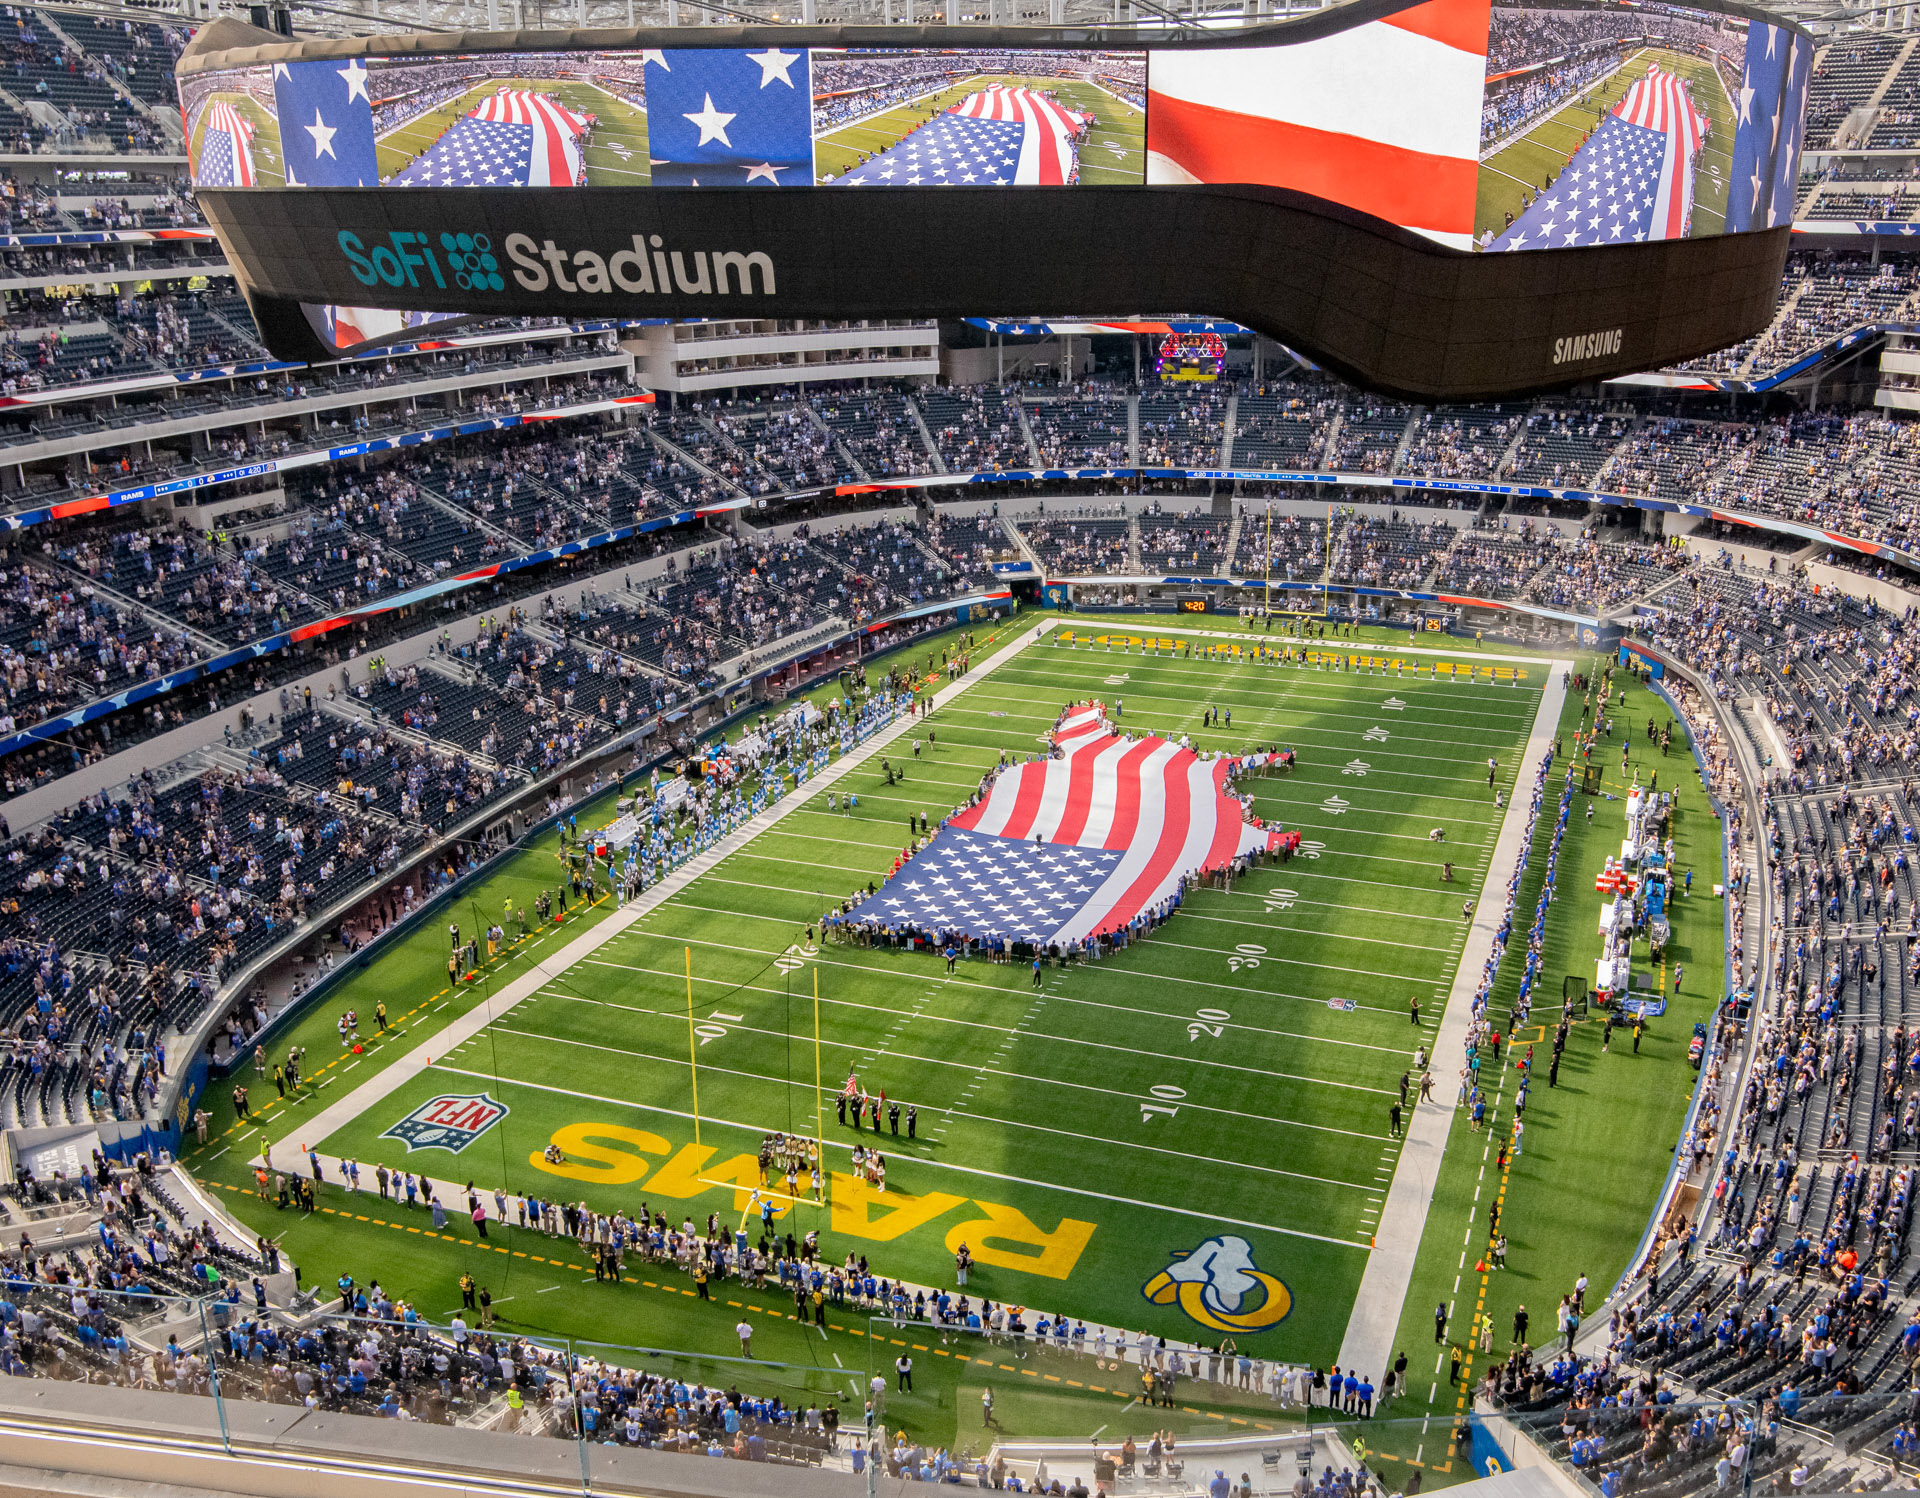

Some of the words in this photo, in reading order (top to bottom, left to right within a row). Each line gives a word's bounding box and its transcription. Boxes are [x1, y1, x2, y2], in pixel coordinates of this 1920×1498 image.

[338, 229, 446, 289] SoFi
[505, 232, 776, 295] Stadium
[1553, 329, 1622, 364] SAMSUNG
[338, 447, 358, 456] RAMS
[121, 491, 144, 502] RAMS
[248, 466, 261, 475] 4:20
[1185, 601, 1205, 611] 4:20
[1427, 619, 1440, 630] 25
[1060, 631, 1189, 650] LOS
[1227, 633, 1285, 642] TAKES
[1381, 699, 1406, 711] 10
[1362, 729, 1390, 742] 20
[1341, 761, 1371, 776] 30
[1320, 799, 1350, 815] 40
[1293, 841, 1326, 859] 50
[1264, 889, 1299, 909] 40
[774, 944, 819, 970] 20
[1227, 943, 1267, 968] 30
[694, 1010, 744, 1038] 10
[1187, 1008, 1230, 1038] 20
[1140, 1085, 1187, 1118] 10
[424, 1100, 498, 1131] NFL
[529, 1122, 1098, 1280] RAMS
